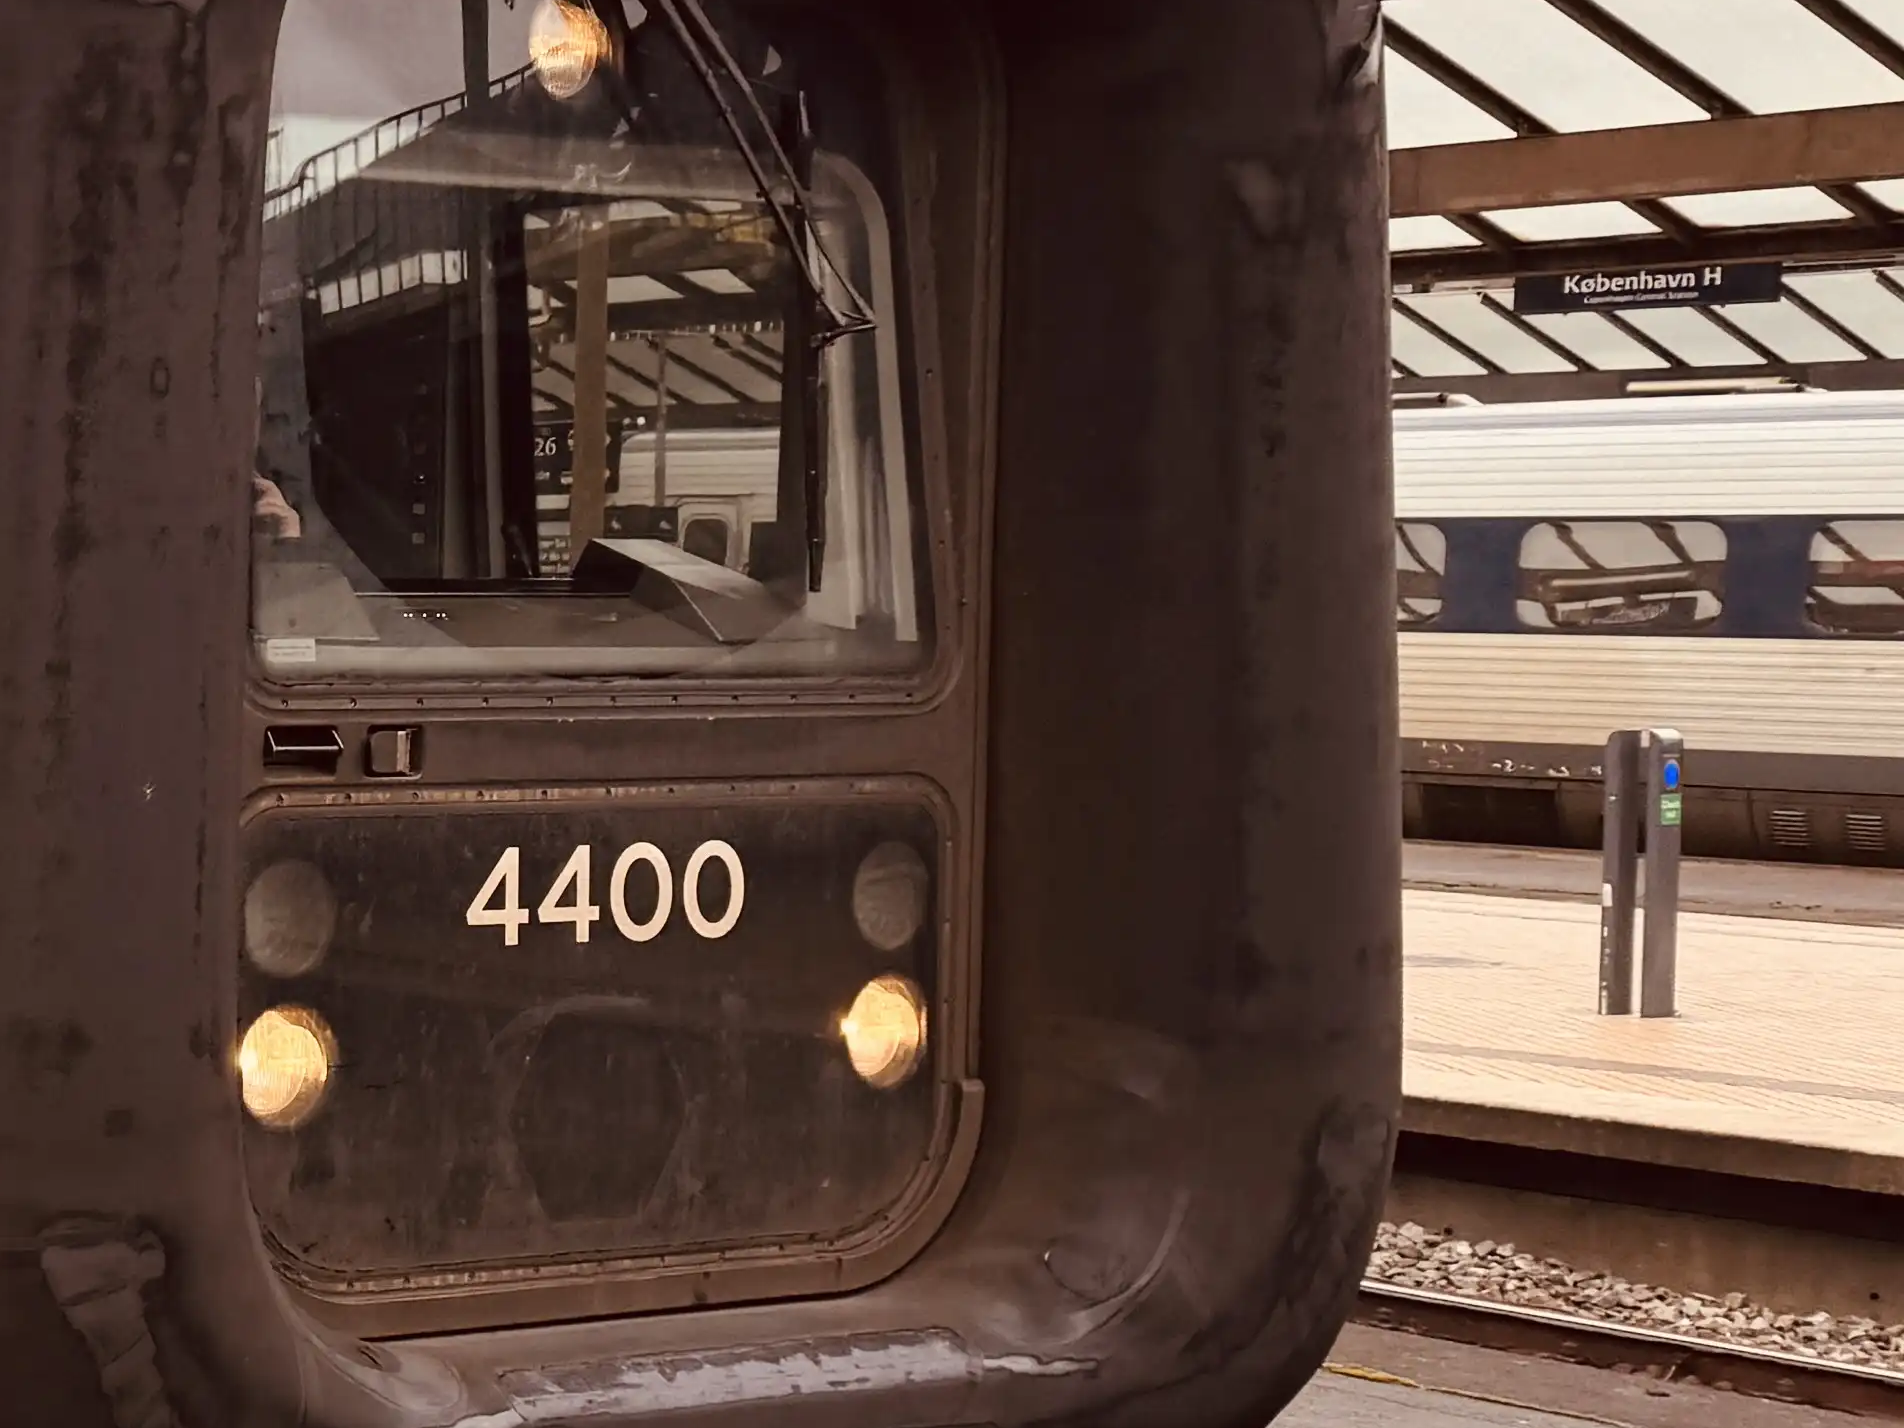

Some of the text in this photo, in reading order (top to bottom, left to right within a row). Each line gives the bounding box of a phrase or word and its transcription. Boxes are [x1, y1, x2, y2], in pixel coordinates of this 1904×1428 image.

[1563, 266, 1723, 295] København H
[533, 436, 557, 457] 26
[465, 837, 747, 947] 4400
